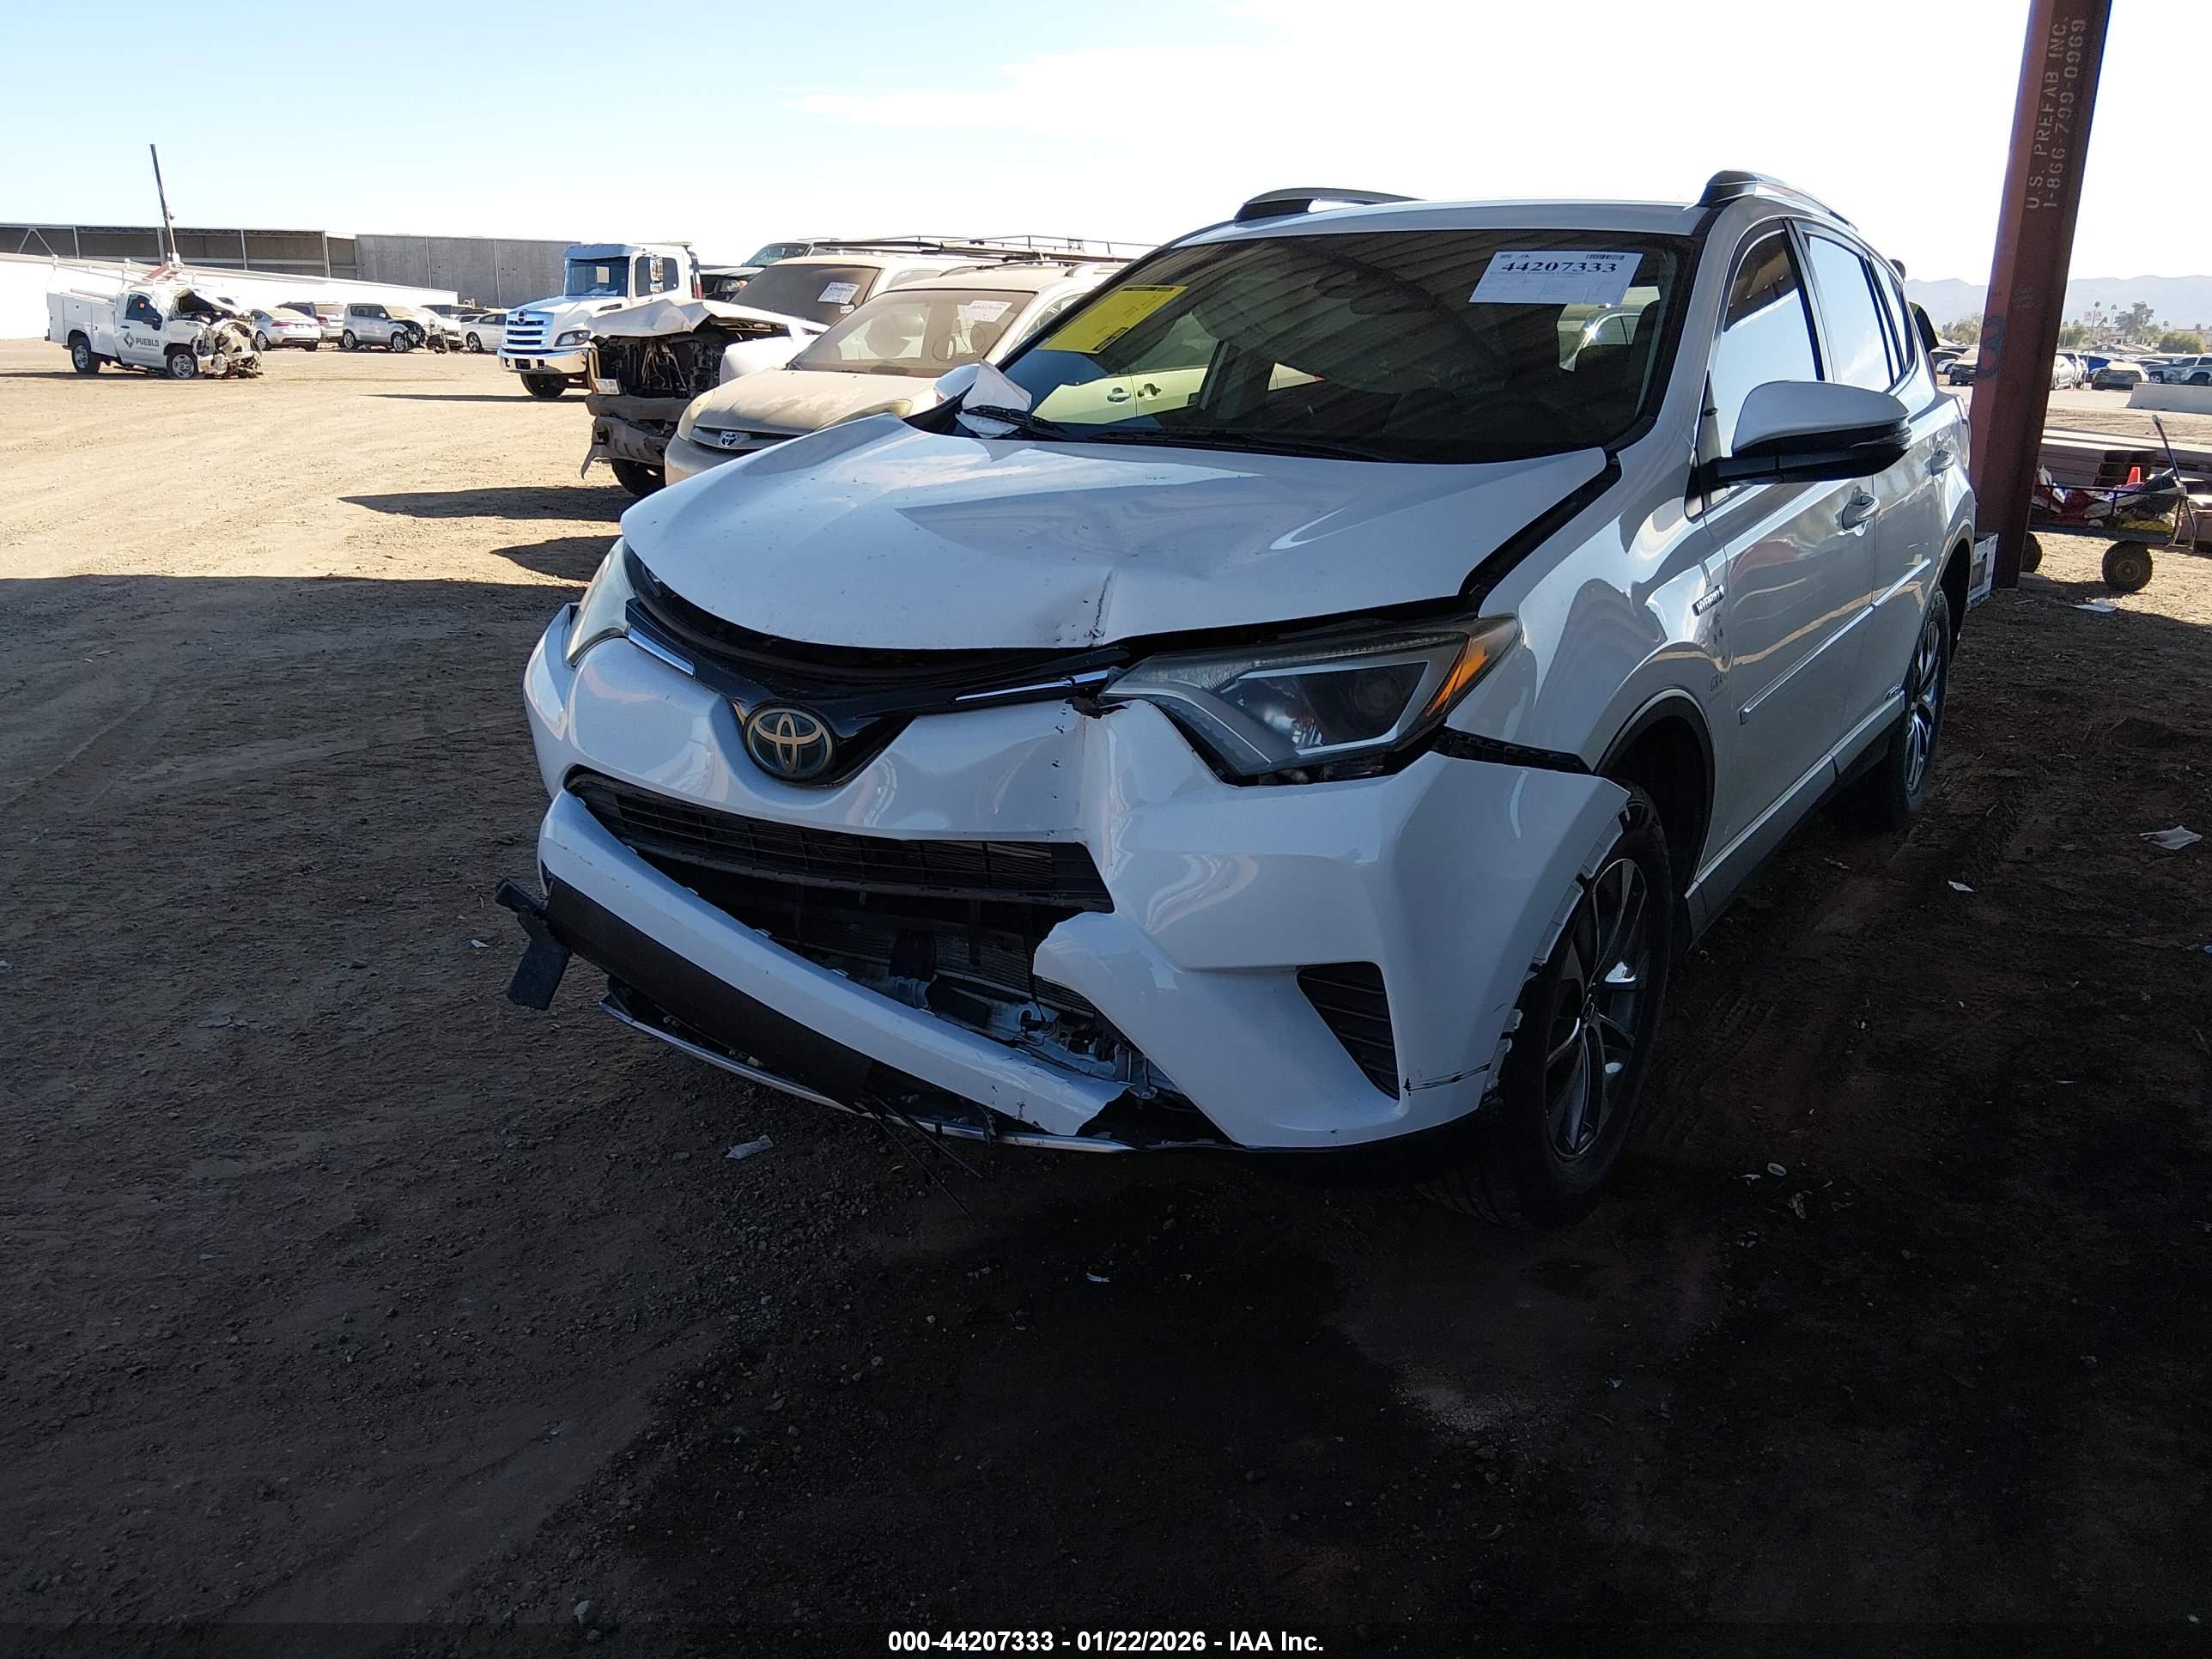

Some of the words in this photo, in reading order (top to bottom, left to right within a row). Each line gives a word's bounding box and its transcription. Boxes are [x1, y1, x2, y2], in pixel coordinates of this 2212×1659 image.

[2048, 17, 2069, 58] INC.
[2033, 71, 2060, 155] PREFAB
[2026, 169, 2045, 209] U.S.
[1502, 261, 1618, 273] 44207333
[136, 337, 159, 347] PUEBLO
